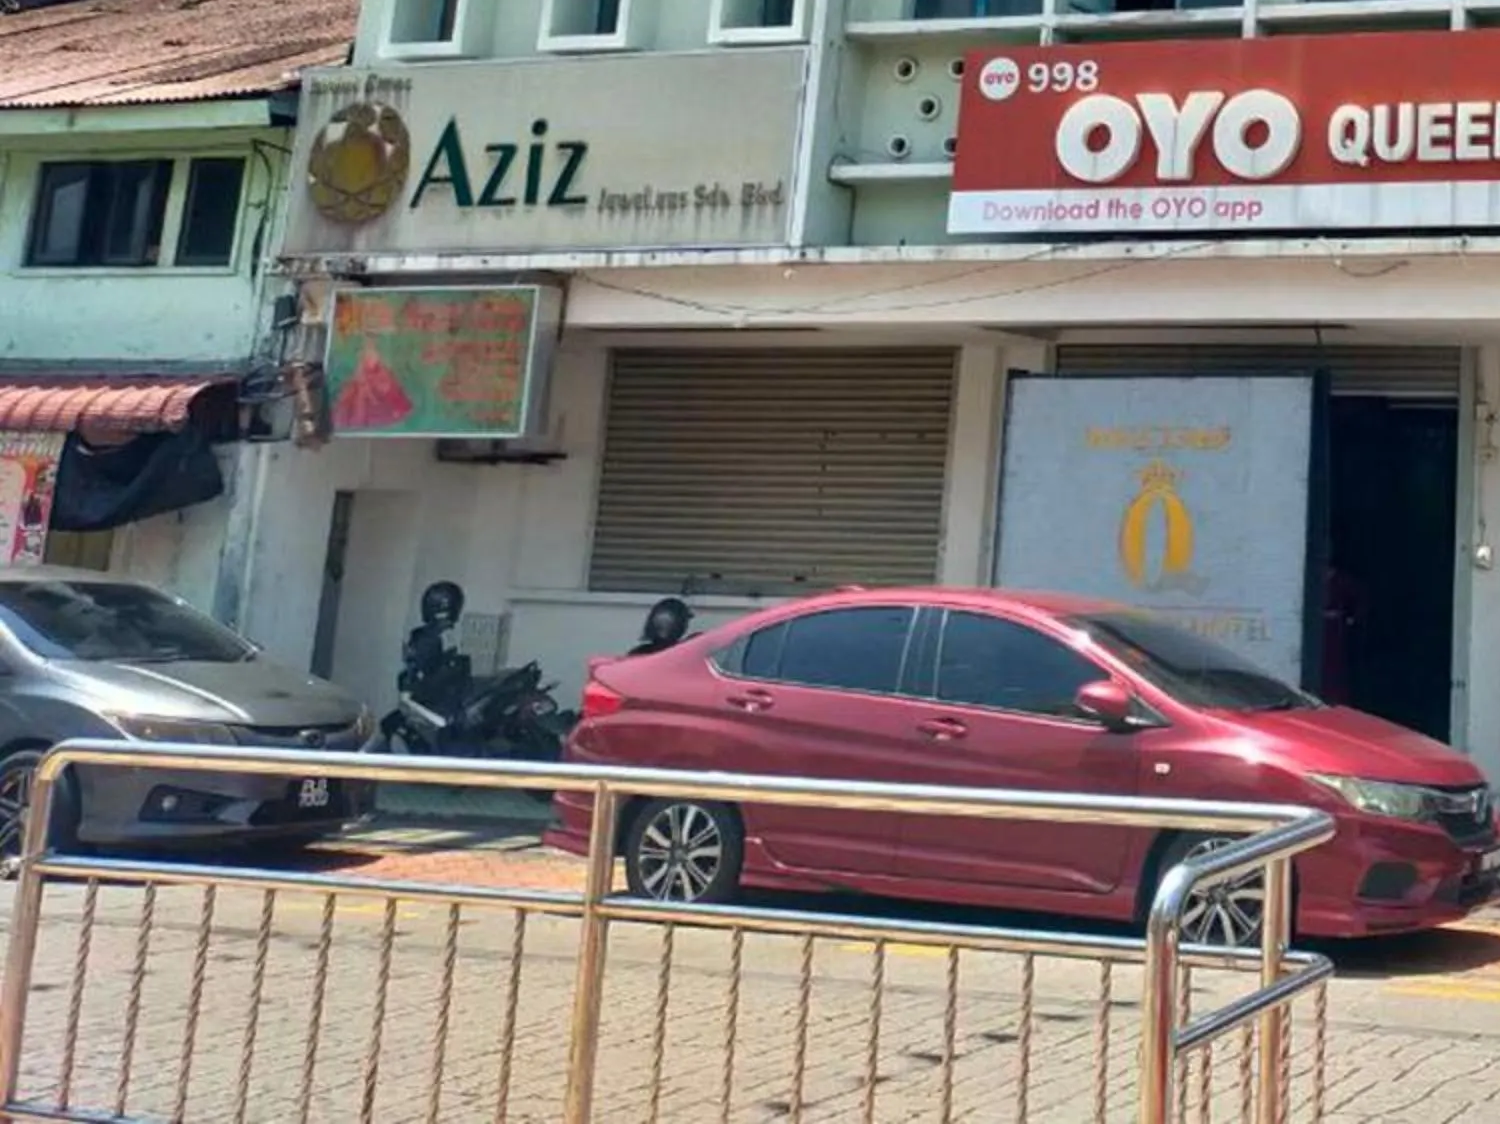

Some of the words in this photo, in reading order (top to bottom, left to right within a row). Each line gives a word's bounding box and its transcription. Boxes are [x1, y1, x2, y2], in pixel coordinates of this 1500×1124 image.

[1028, 60, 1099, 93] 998
[409, 113, 589, 209] Aziz
[1055, 88, 1300, 182] OYO
[982, 199, 1099, 222] Download
[1107, 197, 1143, 220] the
[1151, 196, 1206, 219] OYO
[1213, 199, 1263, 221] app
